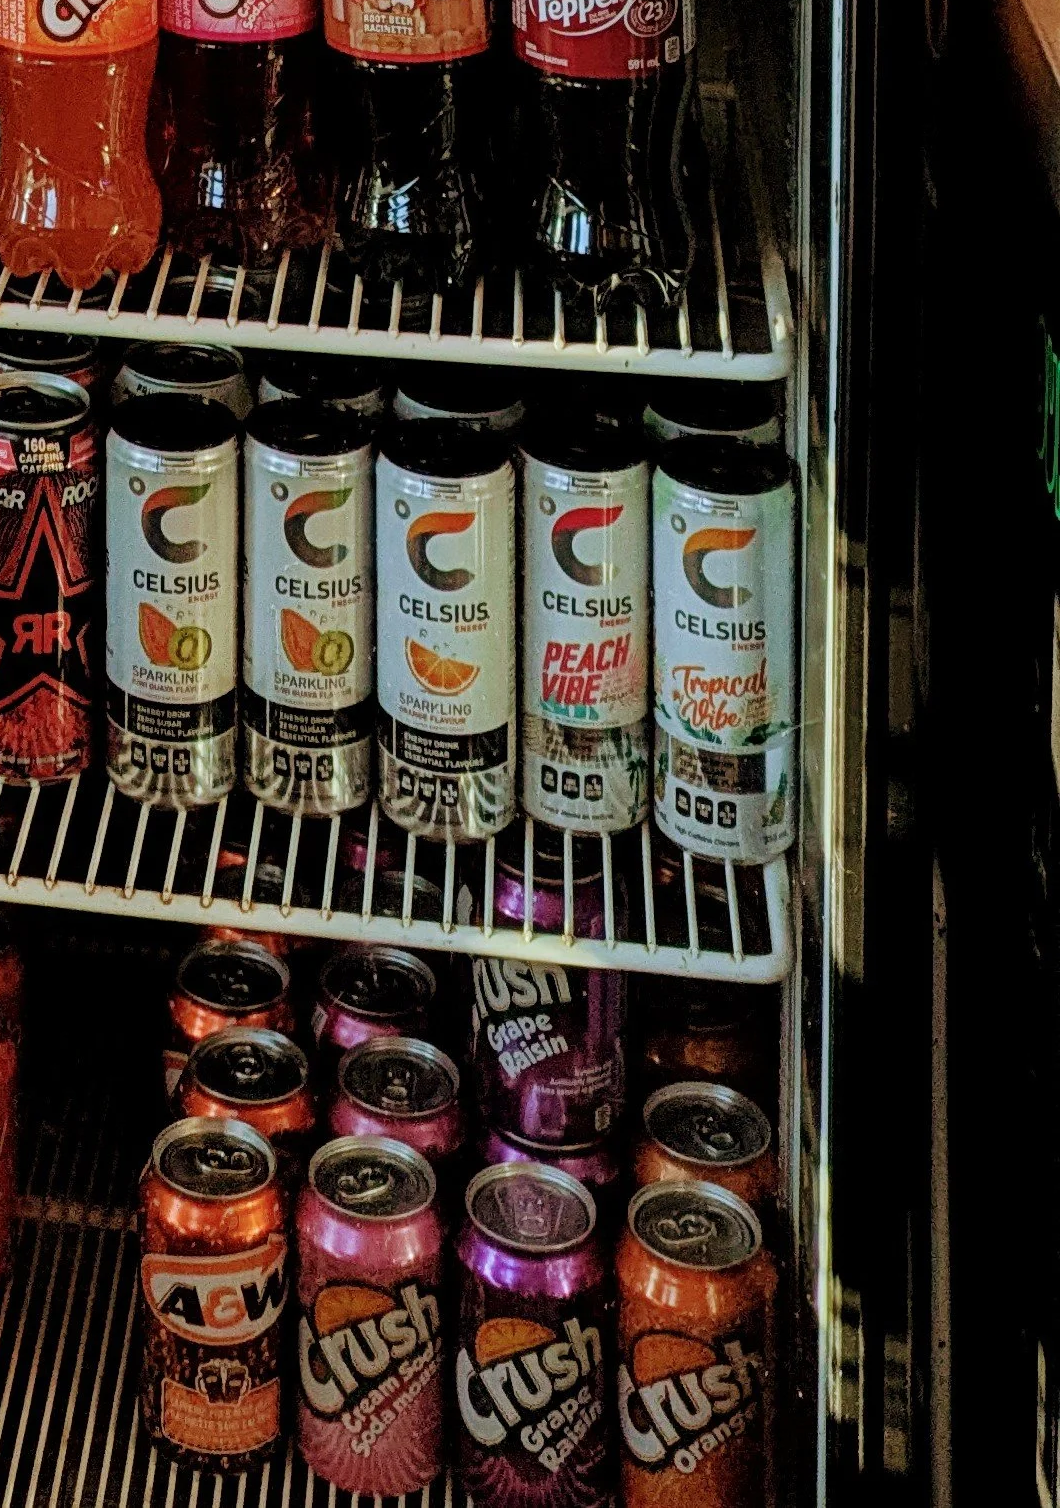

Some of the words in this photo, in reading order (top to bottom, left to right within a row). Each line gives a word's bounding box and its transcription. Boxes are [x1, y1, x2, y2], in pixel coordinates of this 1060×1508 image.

[363, 14, 386, 23] ROOT
[390, 14, 413, 25] BEER
[644, 1, 663, 21] 23
[133, 569, 220, 594] CELSIUS
[275, 575, 362, 600] CELSIUS
[399, 593, 489, 623] CELSIUS
[543, 590, 632, 618] CELSIUS
[675, 609, 766, 641] CELSIUS
[543, 633, 631, 674] PEACH
[541, 673, 602, 705] VIBE
[672, 658, 767, 710] Tropical
[399, 691, 472, 715] SPARKLING
[681, 696, 740, 731] Vibe
[487, 1014, 552, 1053] Grape
[498, 1033, 569, 1080] Raisin
[159, 1265, 283, 1329] A&W
[299, 1284, 440, 1414] Crush
[456, 1317, 602, 1446] Crush
[342, 1377, 400, 1433] Cream
[521, 1385, 592, 1453] Grape
[351, 1405, 396, 1458] Soda
